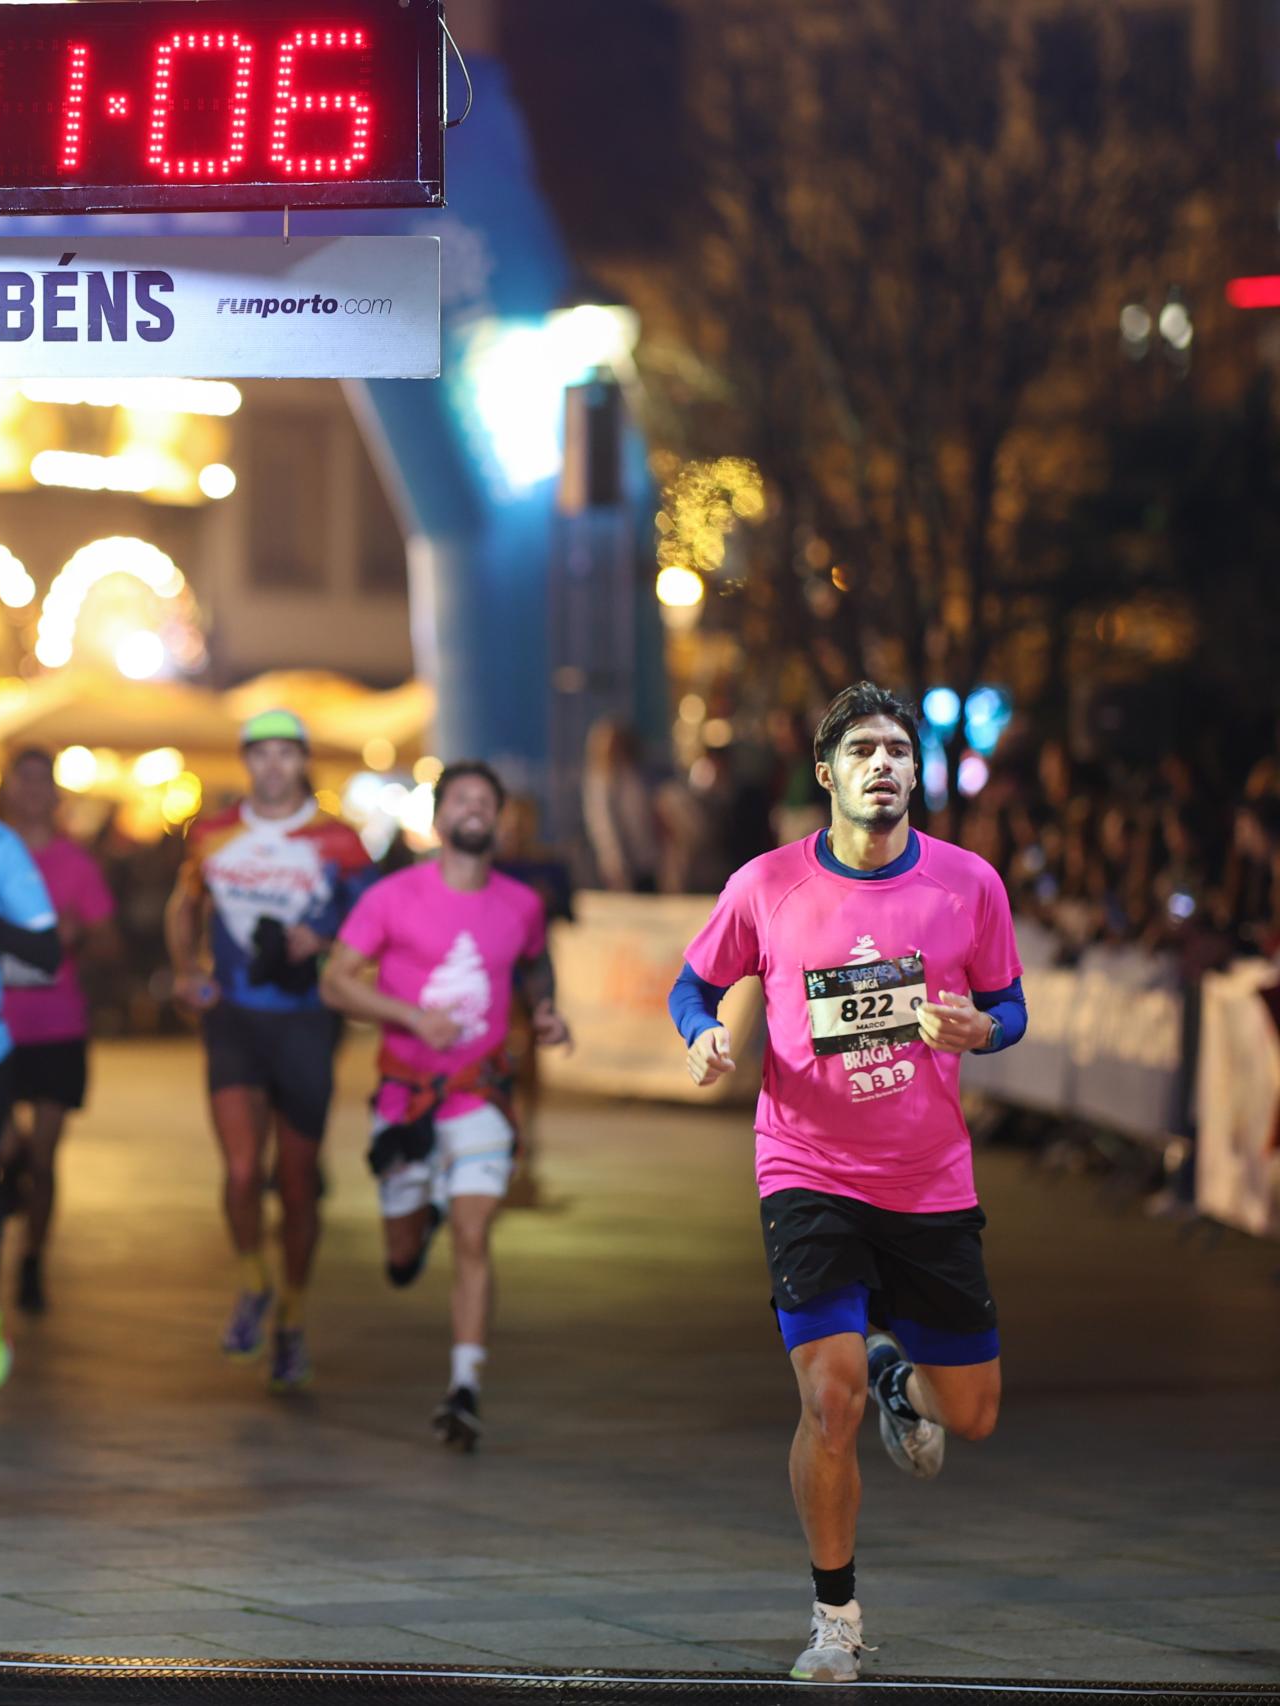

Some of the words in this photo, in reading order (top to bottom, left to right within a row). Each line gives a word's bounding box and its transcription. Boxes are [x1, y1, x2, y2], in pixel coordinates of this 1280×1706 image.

[841, 993, 894, 1022] 822
[856, 1021, 886, 1031] MARCO
[841, 1044, 894, 1071] BRAGA
